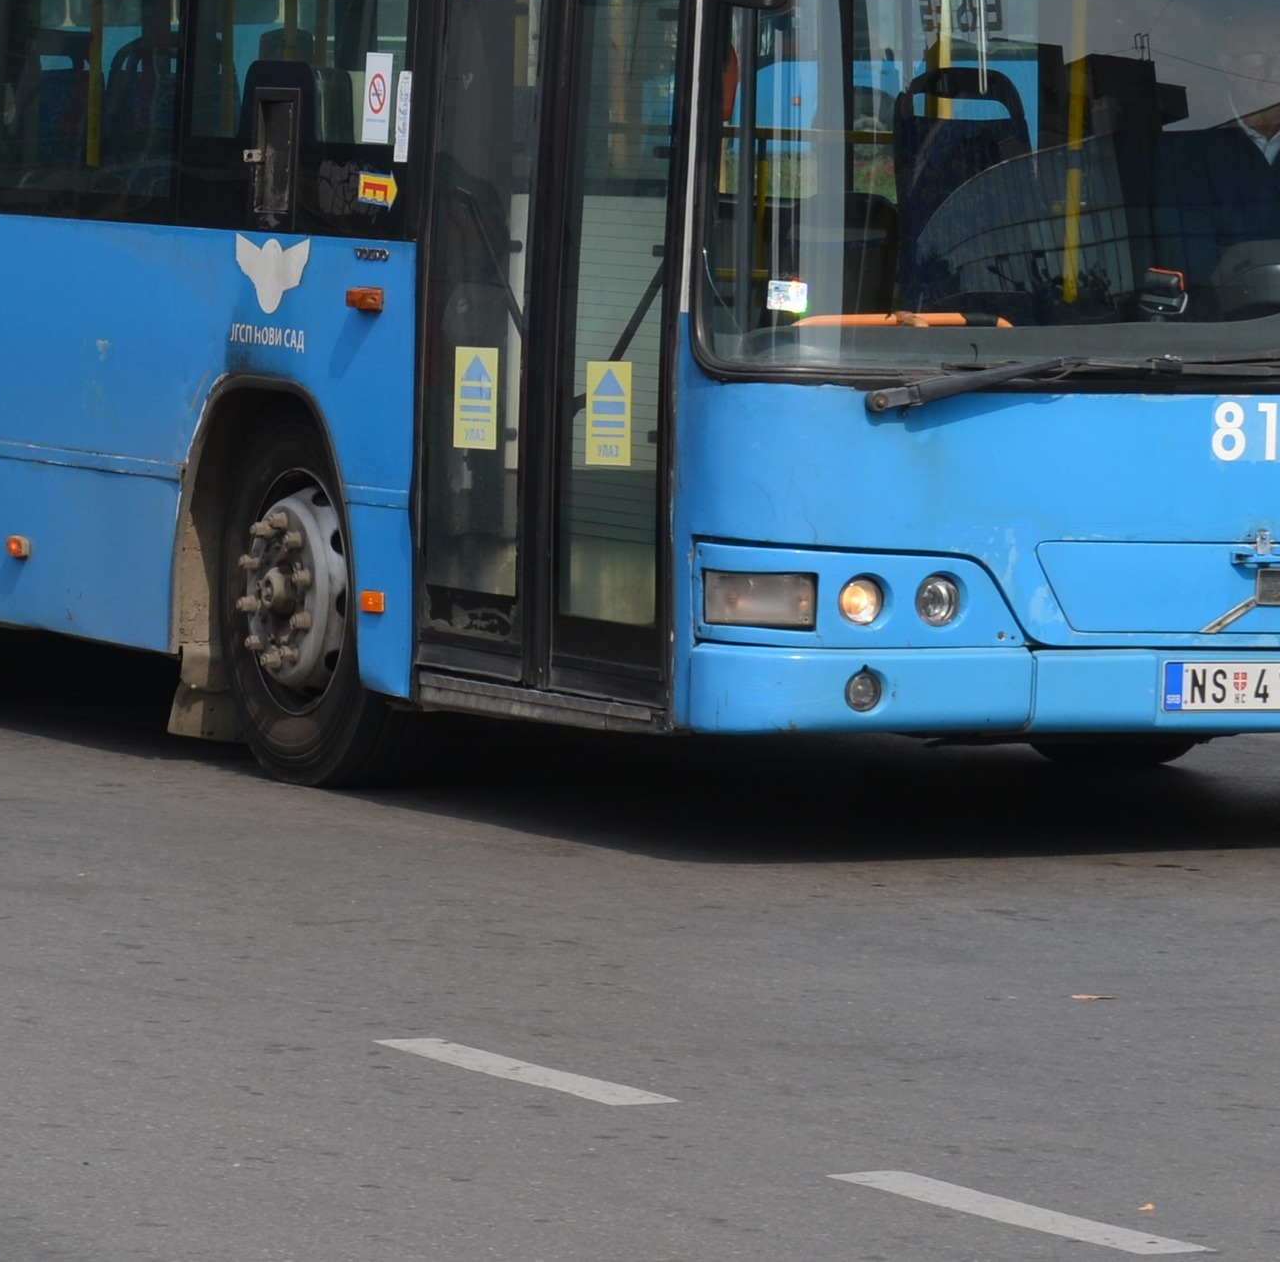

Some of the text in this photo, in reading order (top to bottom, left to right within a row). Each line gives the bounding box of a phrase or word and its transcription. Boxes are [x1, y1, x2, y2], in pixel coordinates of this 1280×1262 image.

[284, 329, 305, 353] САД
[1190, 669, 1227, 704] NS
[1166, 694, 1181, 704] SRB
